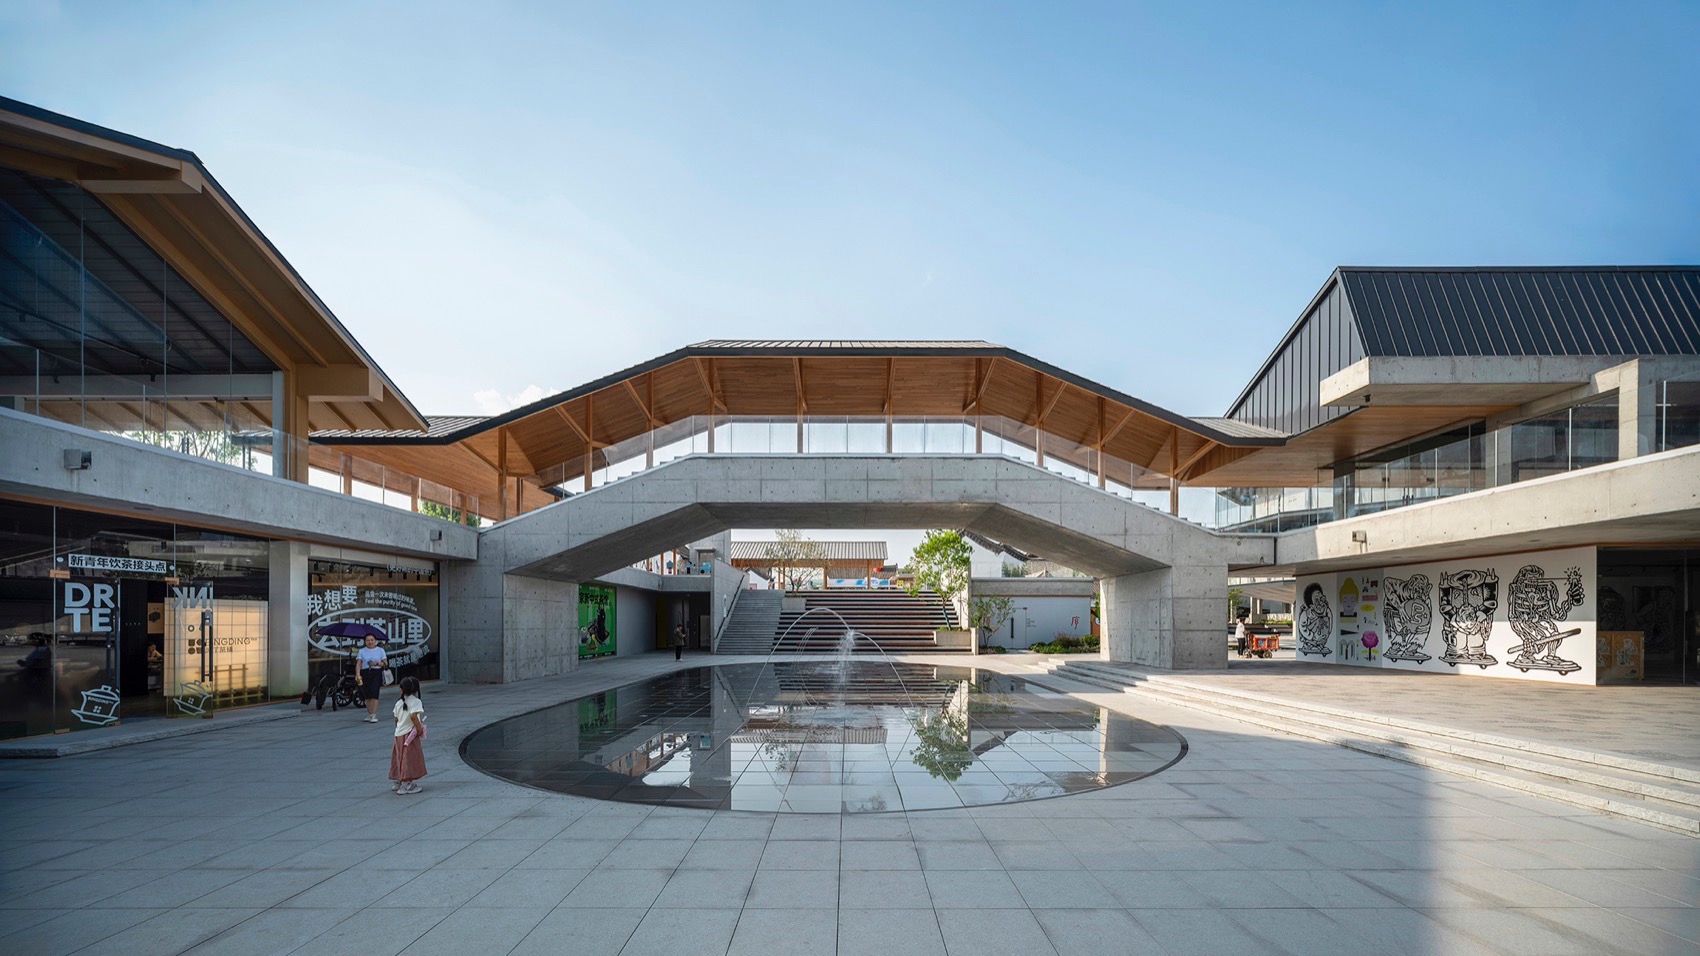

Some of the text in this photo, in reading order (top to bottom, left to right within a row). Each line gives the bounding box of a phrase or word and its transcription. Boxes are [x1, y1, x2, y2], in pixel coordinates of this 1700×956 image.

[70, 555, 166, 572] 新青年饮茶接头点
[306, 585, 358, 616] 我想要
